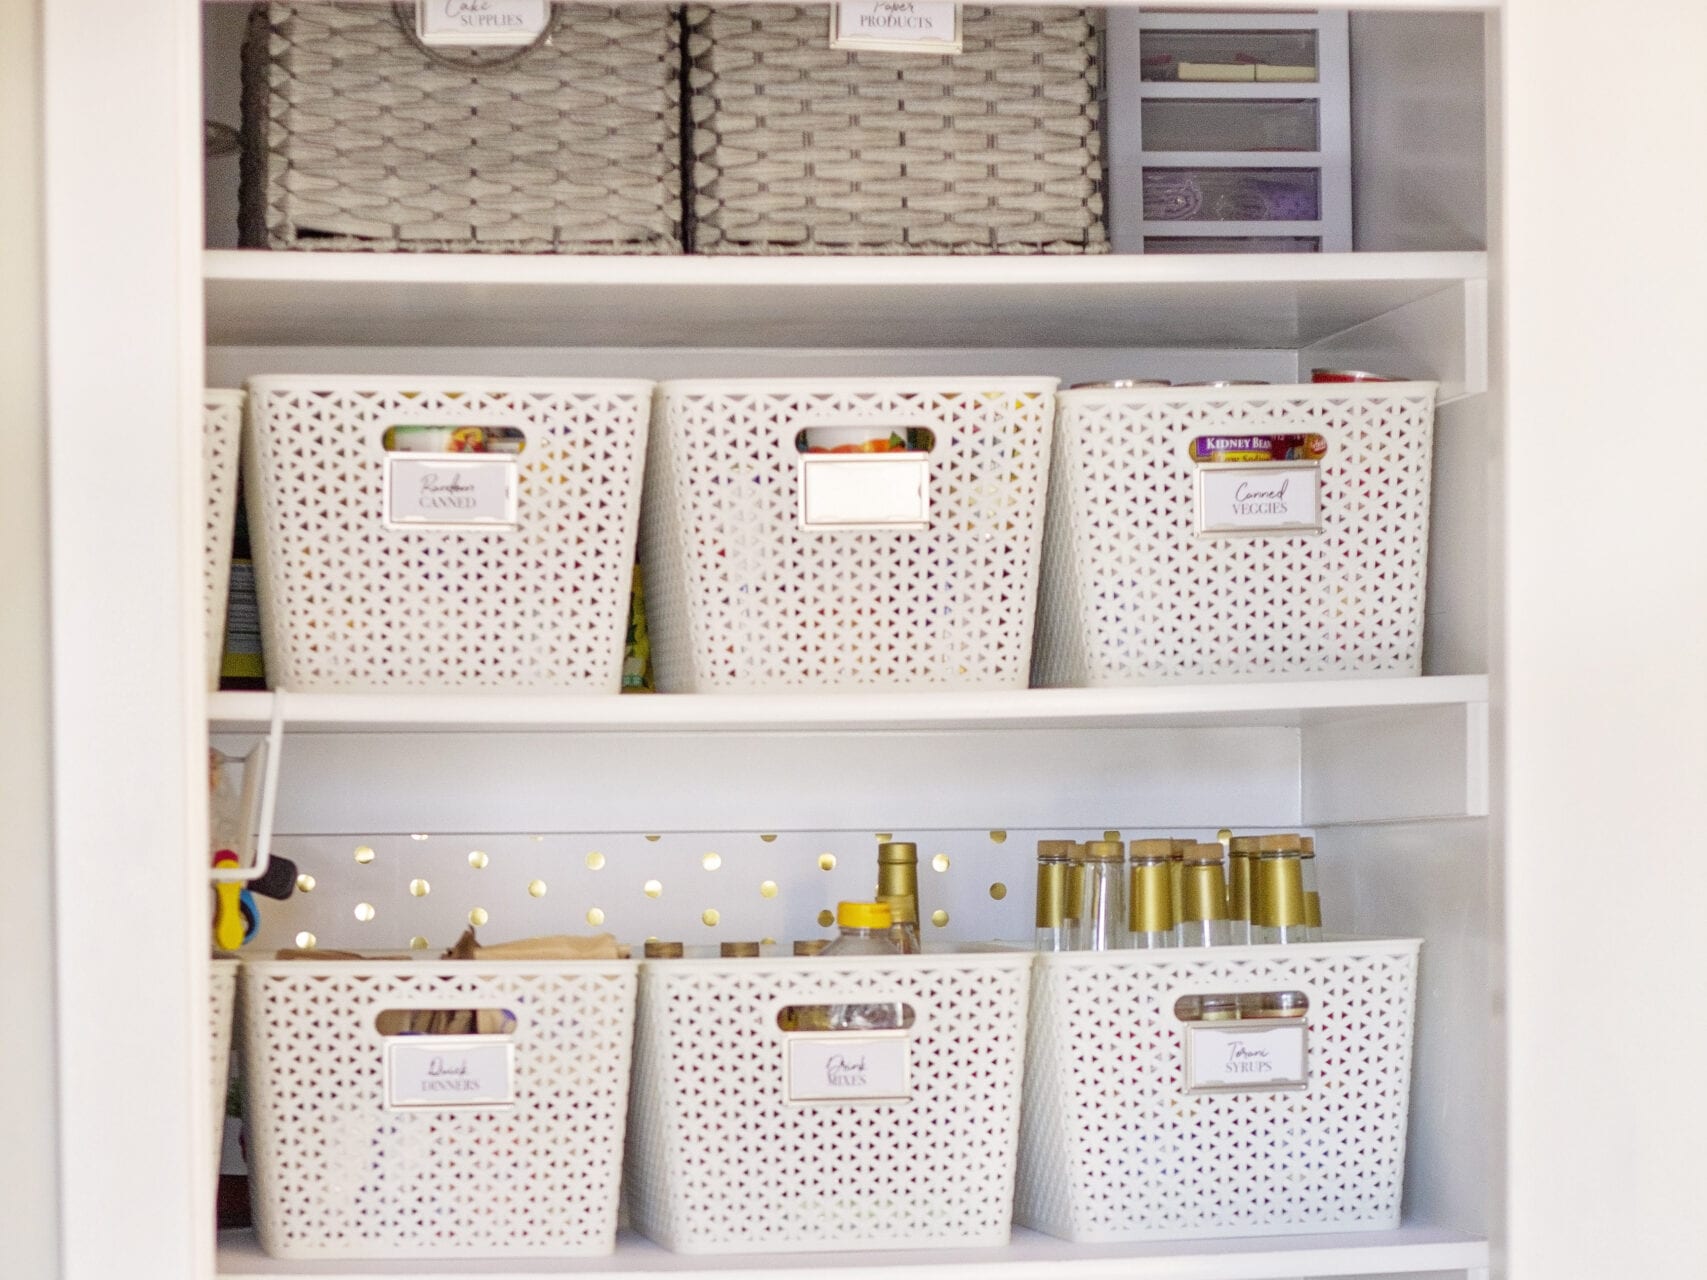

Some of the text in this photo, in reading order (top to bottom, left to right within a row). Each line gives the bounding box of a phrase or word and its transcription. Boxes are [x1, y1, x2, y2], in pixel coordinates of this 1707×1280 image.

[460, 14, 524, 26] SUPPLIES
[860, 14, 933, 28] PRODUCTS
[1207, 437, 1253, 450] KIDNEY
[1235, 479, 1289, 502] Canned
[418, 496, 477, 508] CANNED
[1232, 502, 1288, 515] VEGGIES
[1225, 1061, 1273, 1073] SYRUPS
